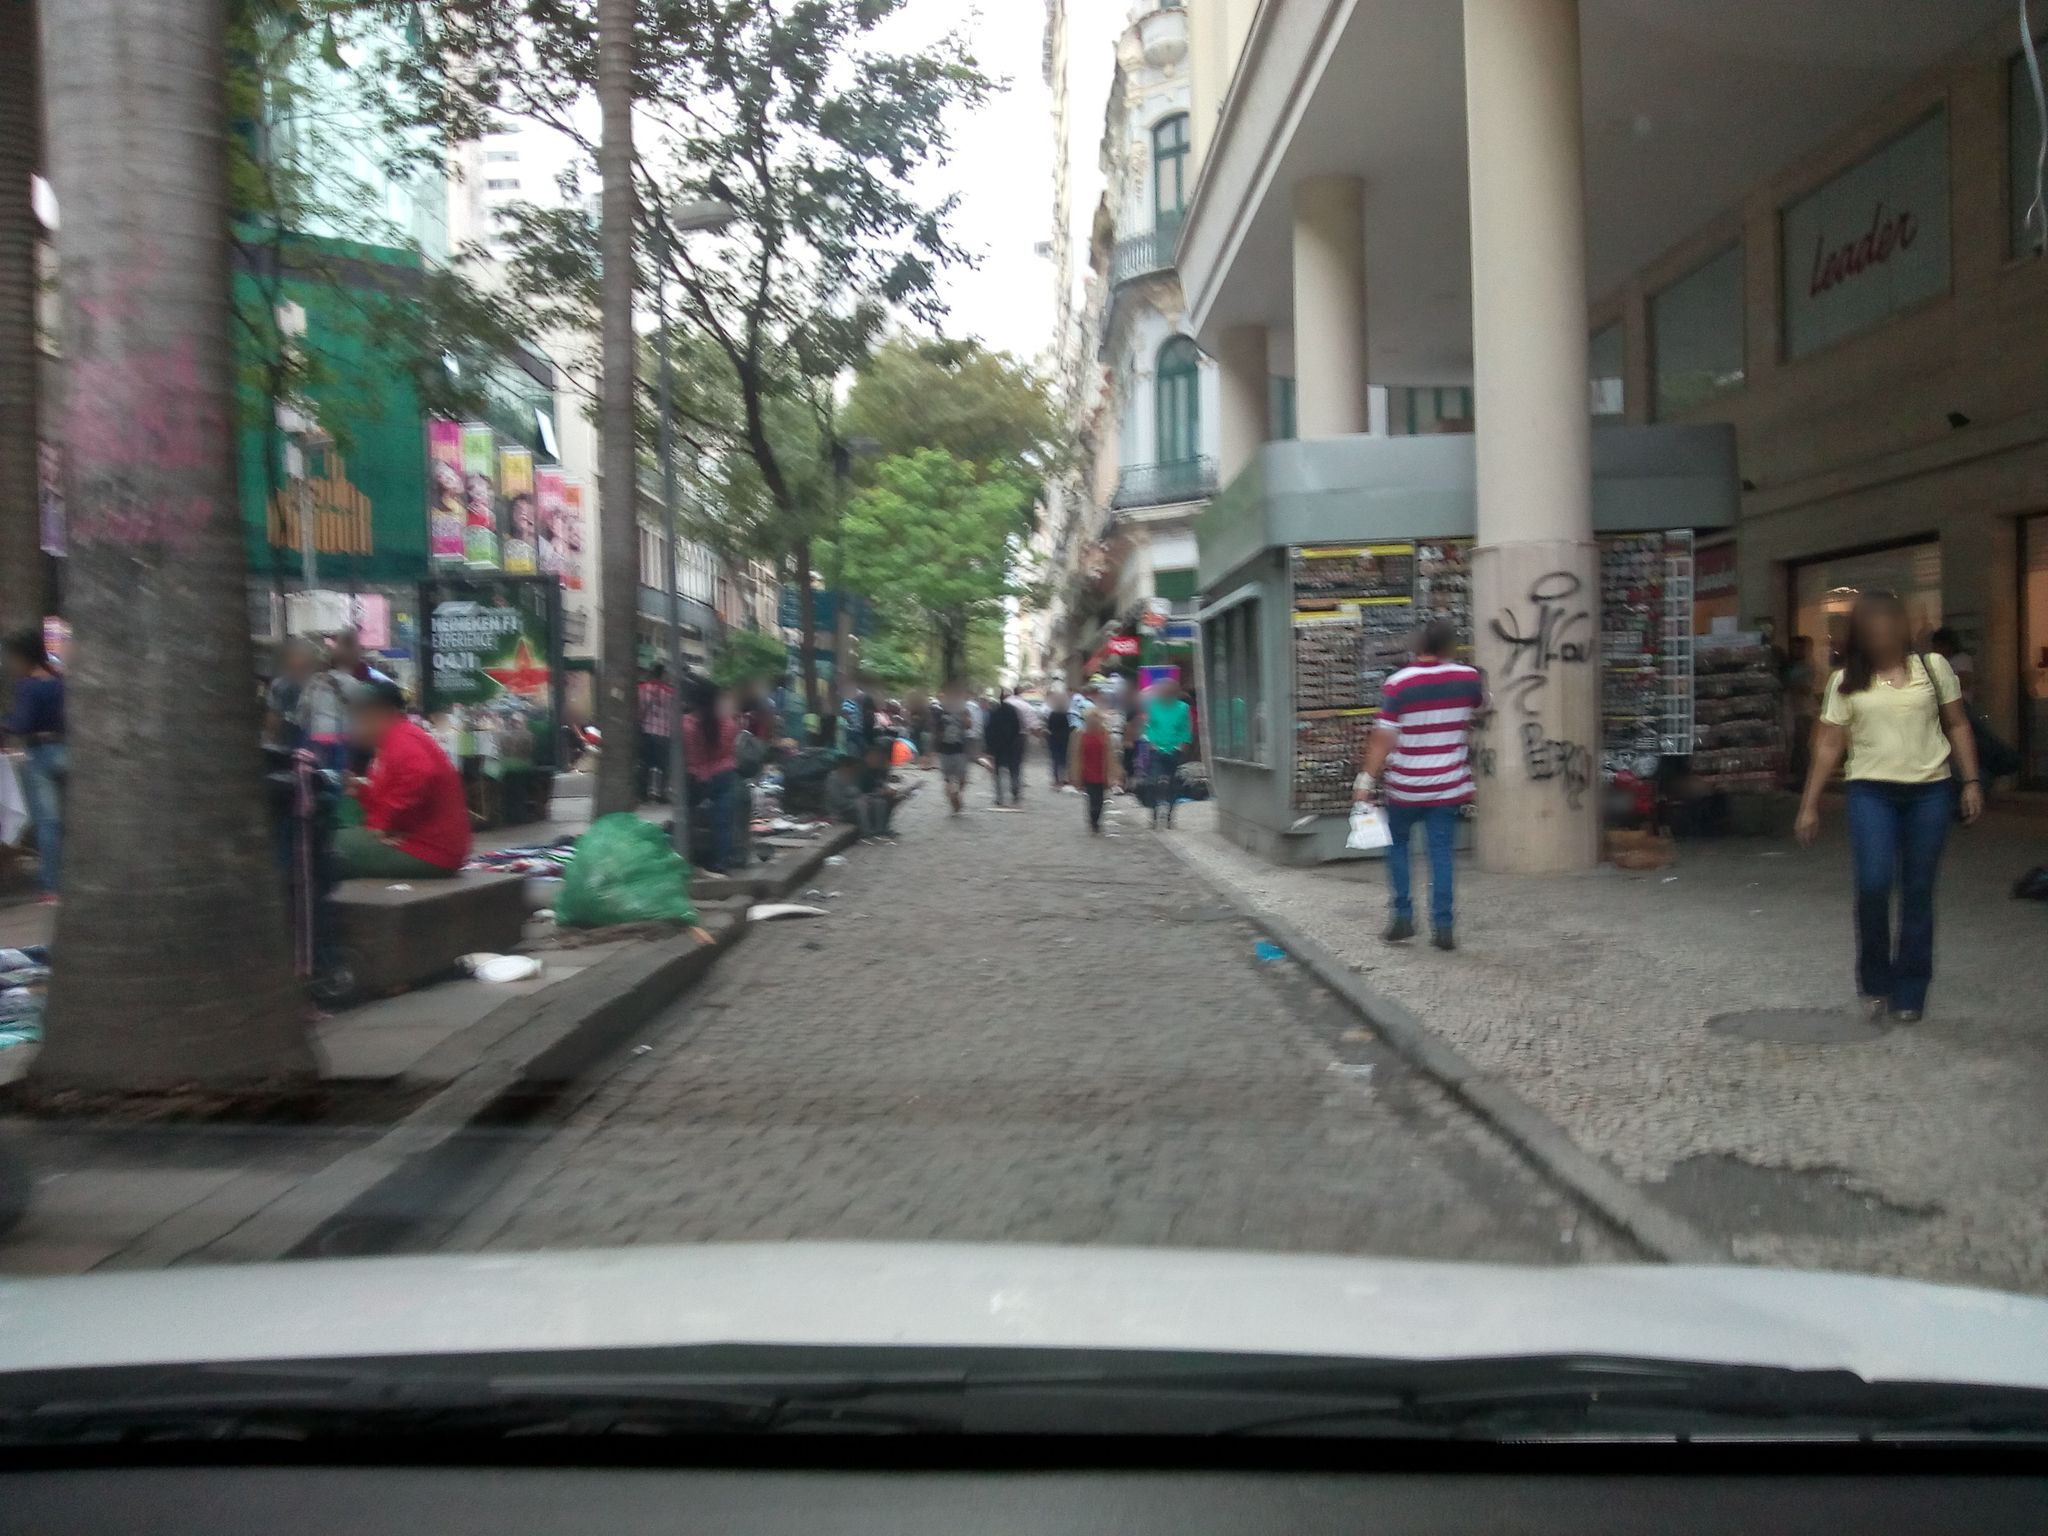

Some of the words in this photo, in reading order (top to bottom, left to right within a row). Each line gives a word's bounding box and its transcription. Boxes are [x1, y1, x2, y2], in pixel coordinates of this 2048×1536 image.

[1808, 200, 1919, 297] Leader
[432, 616, 501, 633] HEINEKEN
[432, 632, 494, 649] EXPERIENCE
